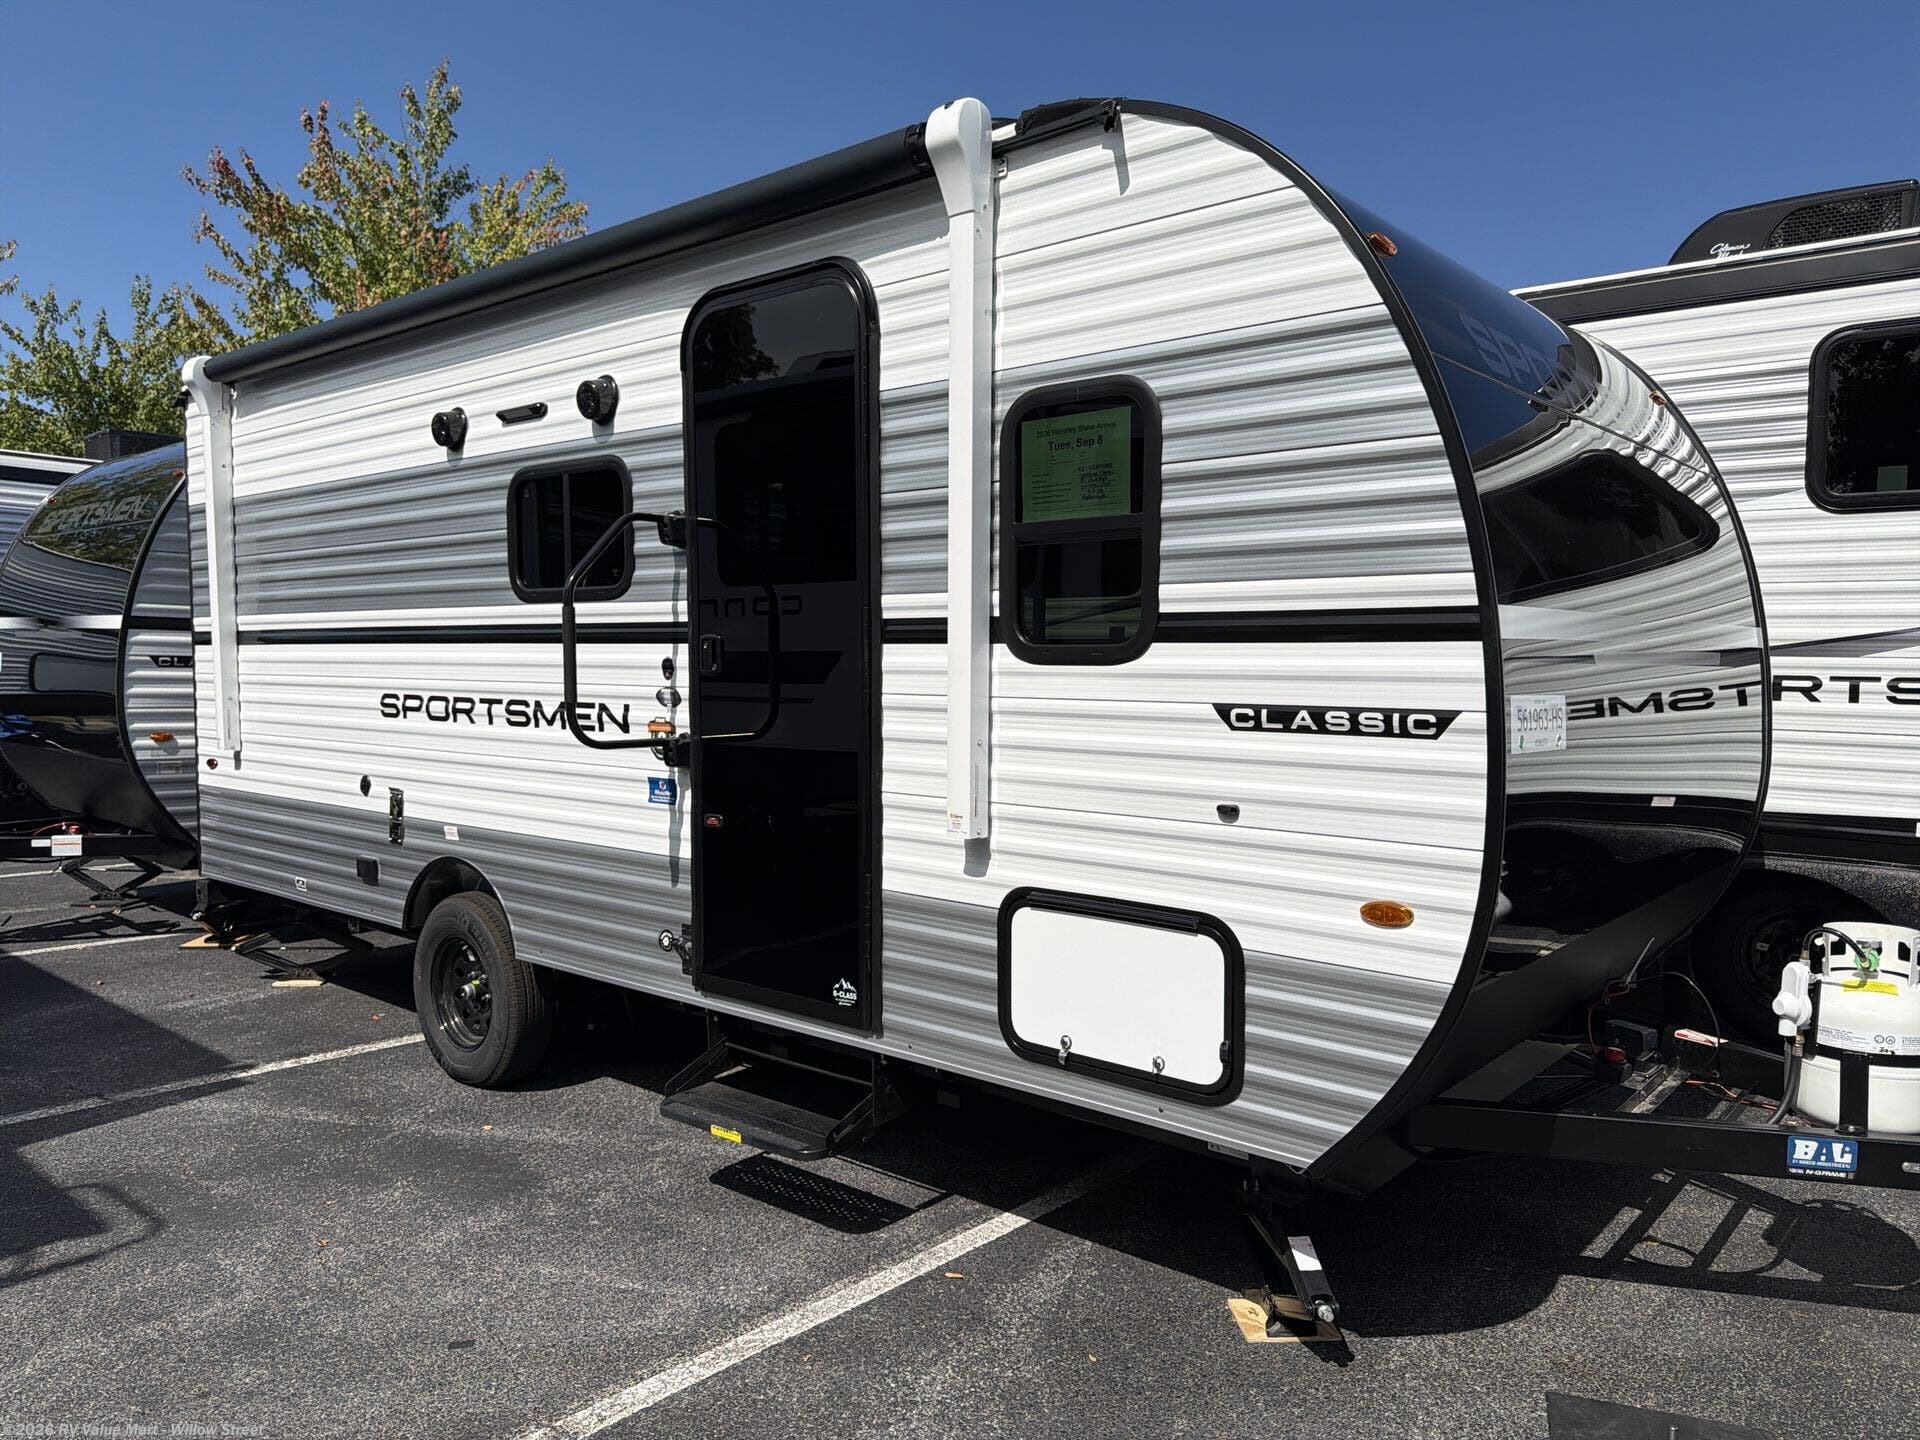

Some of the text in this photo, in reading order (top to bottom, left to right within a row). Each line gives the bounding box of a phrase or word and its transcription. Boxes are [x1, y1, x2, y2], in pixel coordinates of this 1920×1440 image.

[1052, 426, 1077, 437] Hershey
[1078, 423, 1096, 433] Show
[1048, 434, 1104, 452] Tues, Sep 8
[38, 492, 151, 534] SPORTSMEN
[158, 656, 193, 667] CL
[380, 692, 631, 734] SPORTSMEN
[1229, 707, 1438, 736] CLASSIC
[1517, 707, 1563, 732] 561963-HS
